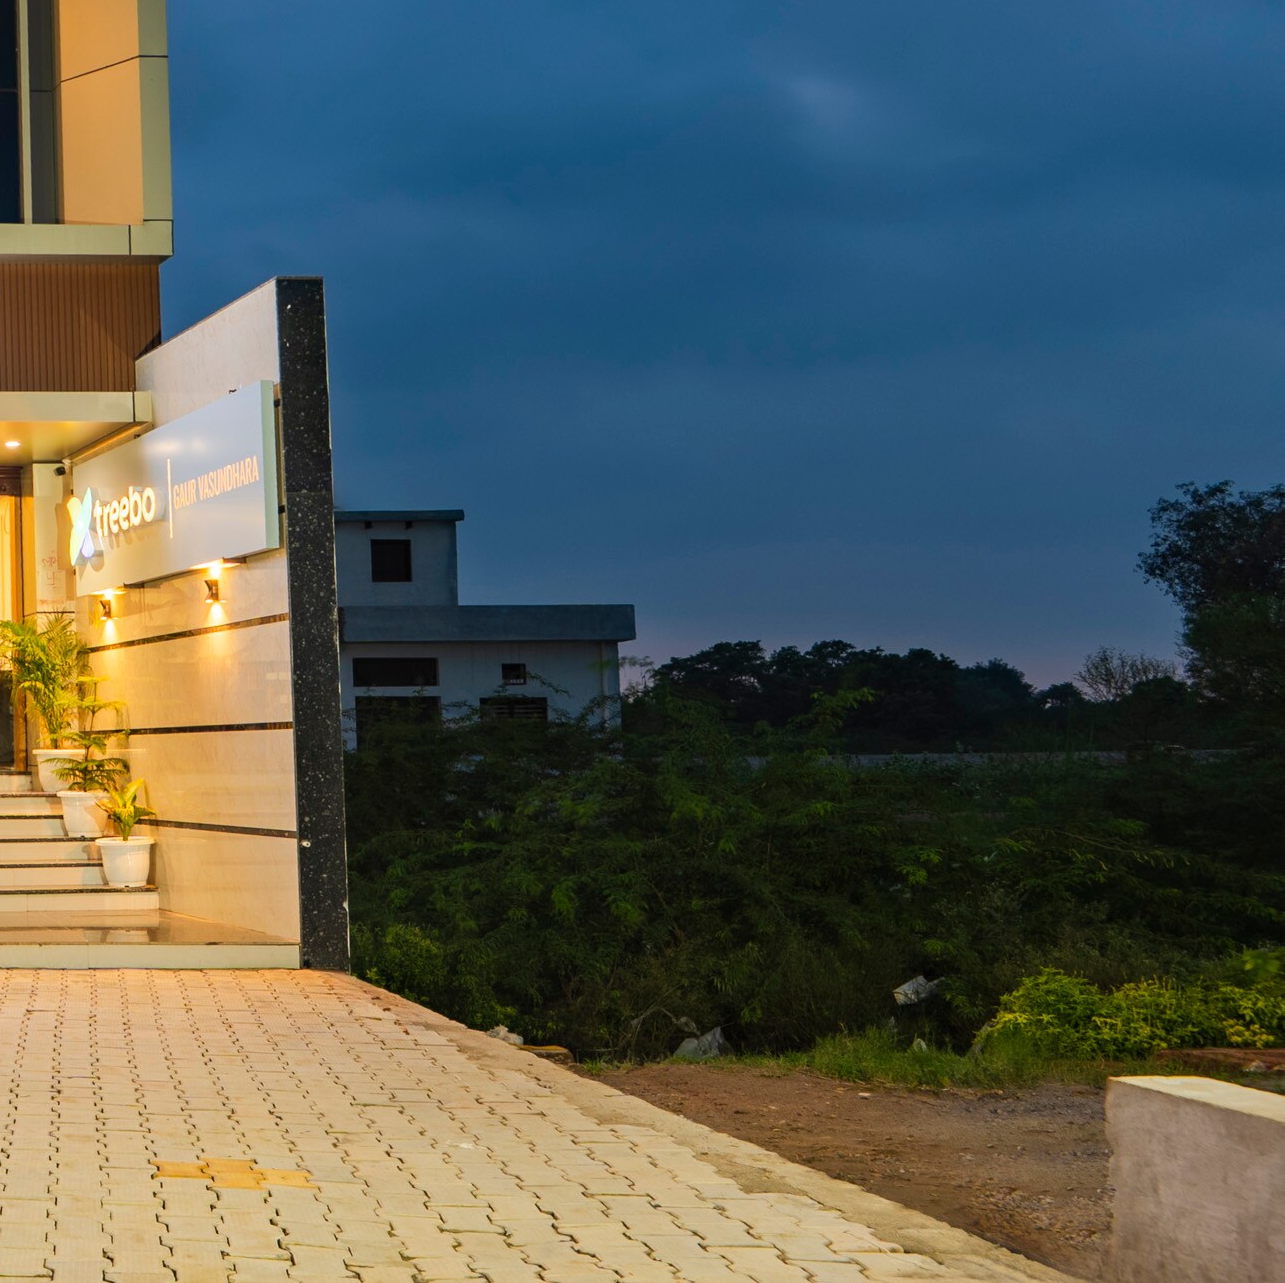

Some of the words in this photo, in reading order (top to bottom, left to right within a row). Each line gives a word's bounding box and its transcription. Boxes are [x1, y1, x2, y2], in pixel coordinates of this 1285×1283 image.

[93, 485, 156, 537] treebo
[173, 479, 197, 510] GAUR
[198, 455, 260, 501] VASUNDHARA
